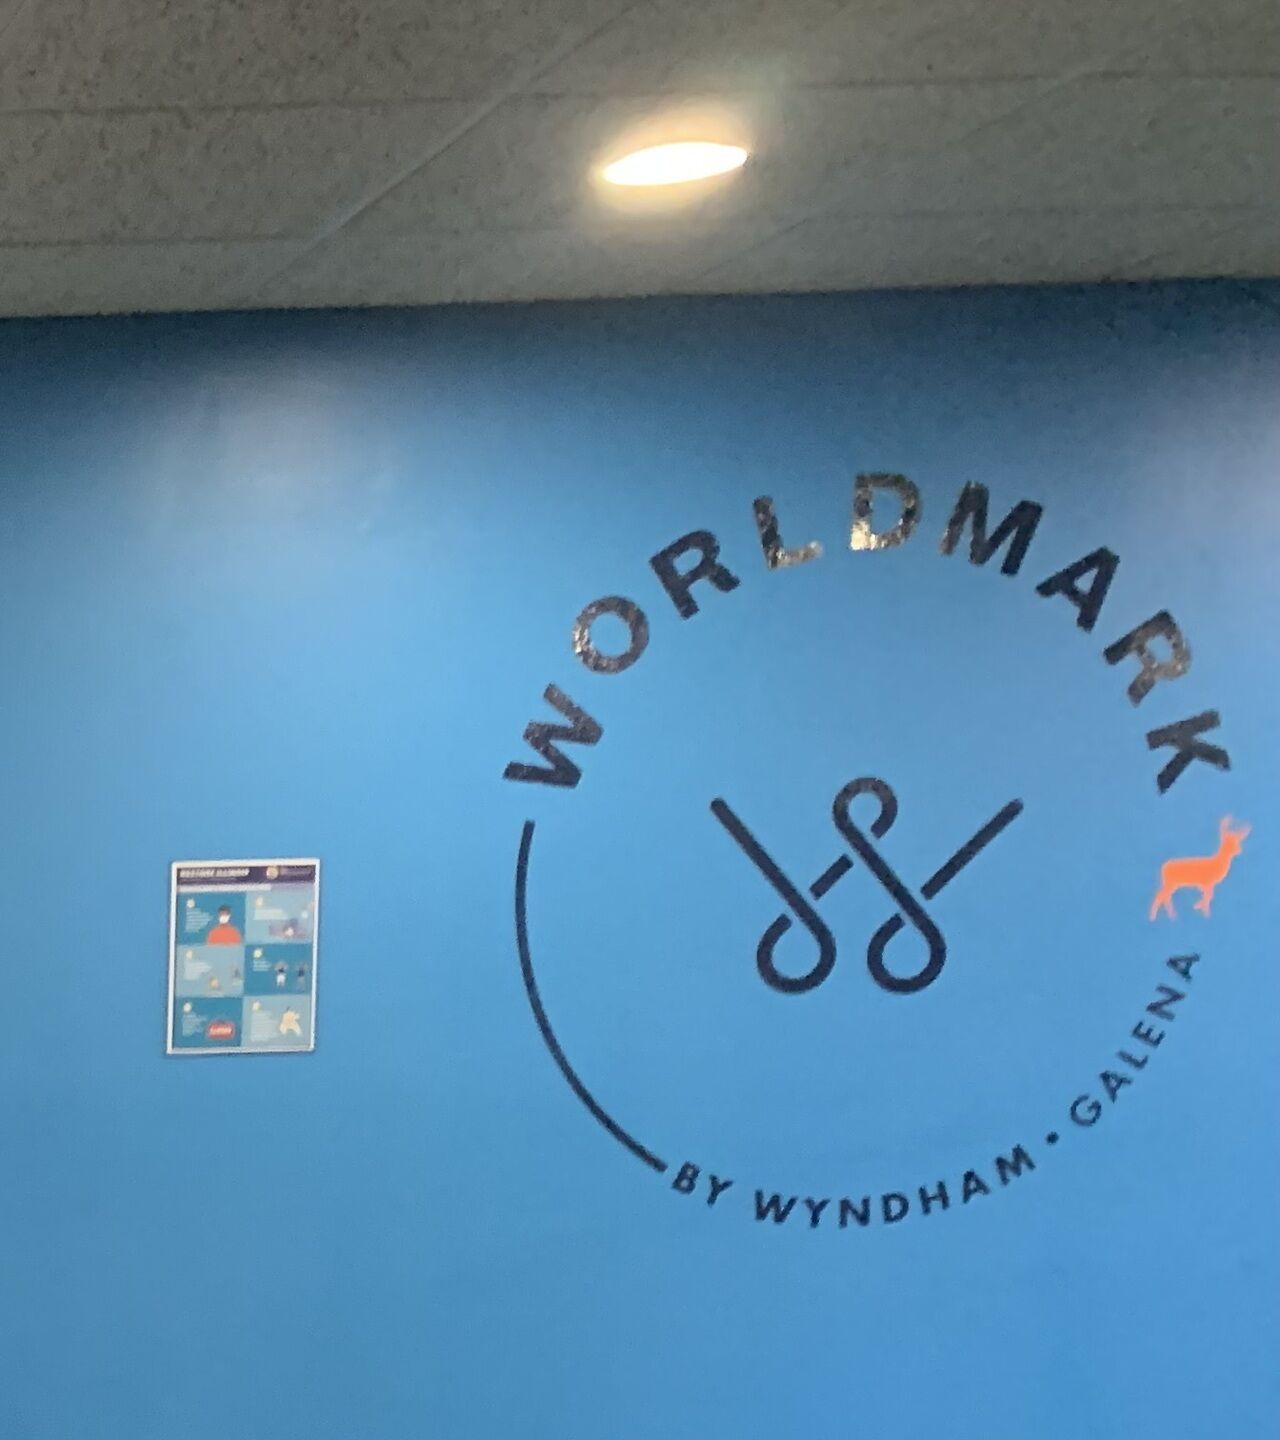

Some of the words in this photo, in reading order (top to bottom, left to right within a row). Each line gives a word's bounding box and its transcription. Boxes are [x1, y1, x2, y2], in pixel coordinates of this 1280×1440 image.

[502, 472, 1231, 795] WORLDMARK
[671, 1159, 733, 1206] BY
[753, 1142, 1037, 1229] WYNDHAM
[1069, 949, 1201, 1128] GALENA
